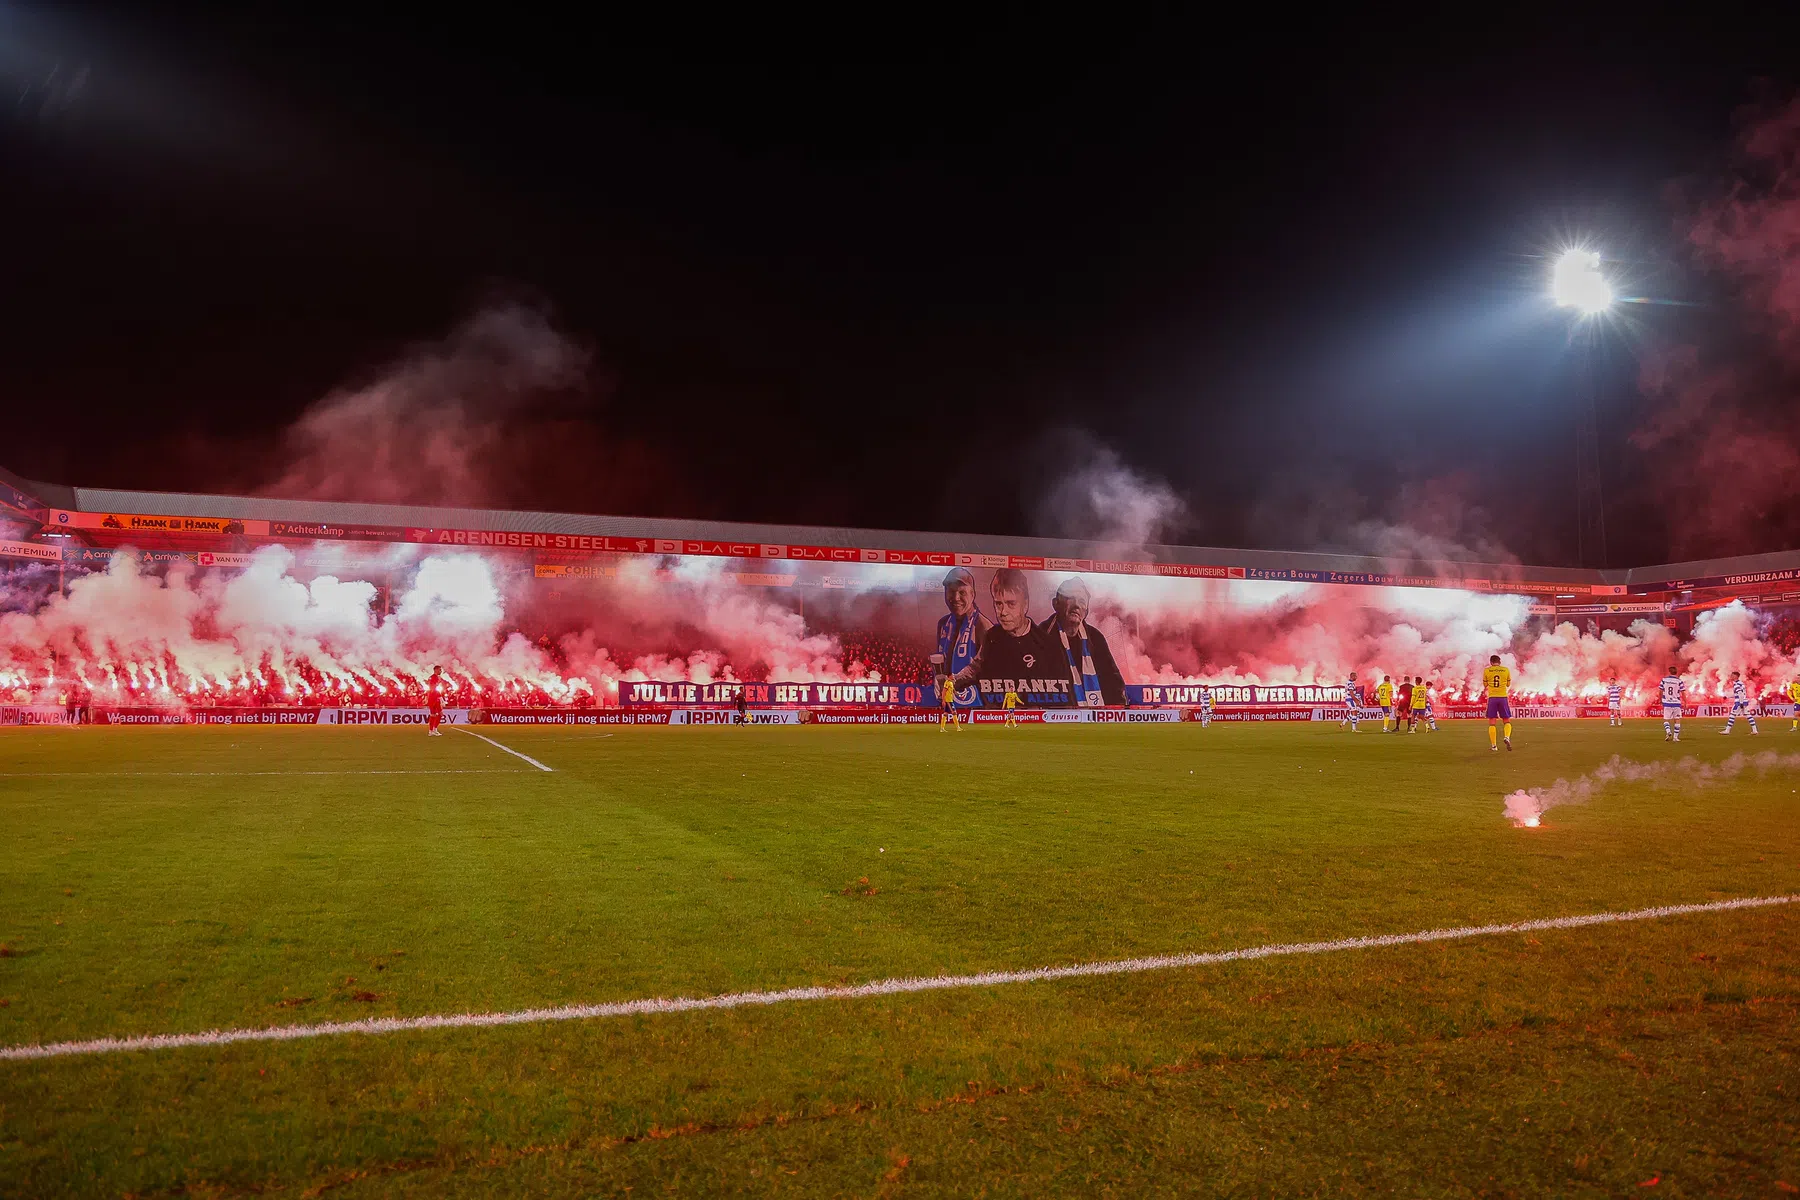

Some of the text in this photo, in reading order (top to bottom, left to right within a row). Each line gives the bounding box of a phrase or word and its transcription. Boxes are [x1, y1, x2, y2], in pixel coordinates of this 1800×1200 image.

[287, 525, 344, 537] Achterkamp
[438, 530, 615, 550] ARENDSEN-STEEL
[3, 545, 57, 557] ACTEMIUM
[688, 543, 723, 554] DLA
[729, 544, 755, 555] ICT
[792, 547, 825, 558] DLA
[830, 549, 856, 559] ICT
[890, 553, 922, 563] DLA
[926, 554, 950, 564] ICT
[564, 566, 606, 575] COHEN
[1110, 562, 1132, 572] DALES
[1133, 564, 1182, 576] ACCOUNTANTS
[1183, 566, 1189, 576] &
[1190, 567, 1226, 577] ADVISEURS
[1250, 568, 1318, 580] Zegers Bouw
[1330, 572, 1394, 584] Zegers Bouw
[1724, 571, 1793, 584] VERDUURZAAM
[979, 679, 1070, 693] BEDANKT
[1493, 675, 1500, 688] 6
[629, 684, 697, 702] JULLIE
[775, 685, 811, 703] HET
[816, 685, 899, 703] VUURTJE
[1143, 687, 1161, 702] DE
[1165, 687, 1251, 703] VIJVRBERG
[1254, 687, 1294, 702] WEER
[1667, 686, 1674, 696] 8
[1027, 693, 1069, 703] ALLES
[4, 708, 20, 724] RPM
[107, 712, 315, 725] Waarom werk jij nog niet bij RPM?
[344, 711, 388, 724] RPM
[490, 713, 668, 724] Waarom werk jij nog niet bij RPM?
[692, 711, 729, 724] RPM
[816, 713, 855, 723] Waarom
[857, 713, 880, 723] werk
[880, 713, 889, 724] jij
[891, 715, 908, 724] nog
[910, 713, 927, 723] niet
[928, 713, 939, 724] bij
[976, 713, 1040, 722] Keuken Kmpioen
[1097, 711, 1126, 722] RPM
[1225, 712, 1242, 720] werk
[1251, 714, 1264, 722] nog
[1265, 712, 1279, 720] niet
[1280, 712, 1289, 722] bij
[1290, 712, 1310, 720] RPM?
[1518, 709, 1538, 718] RPM
